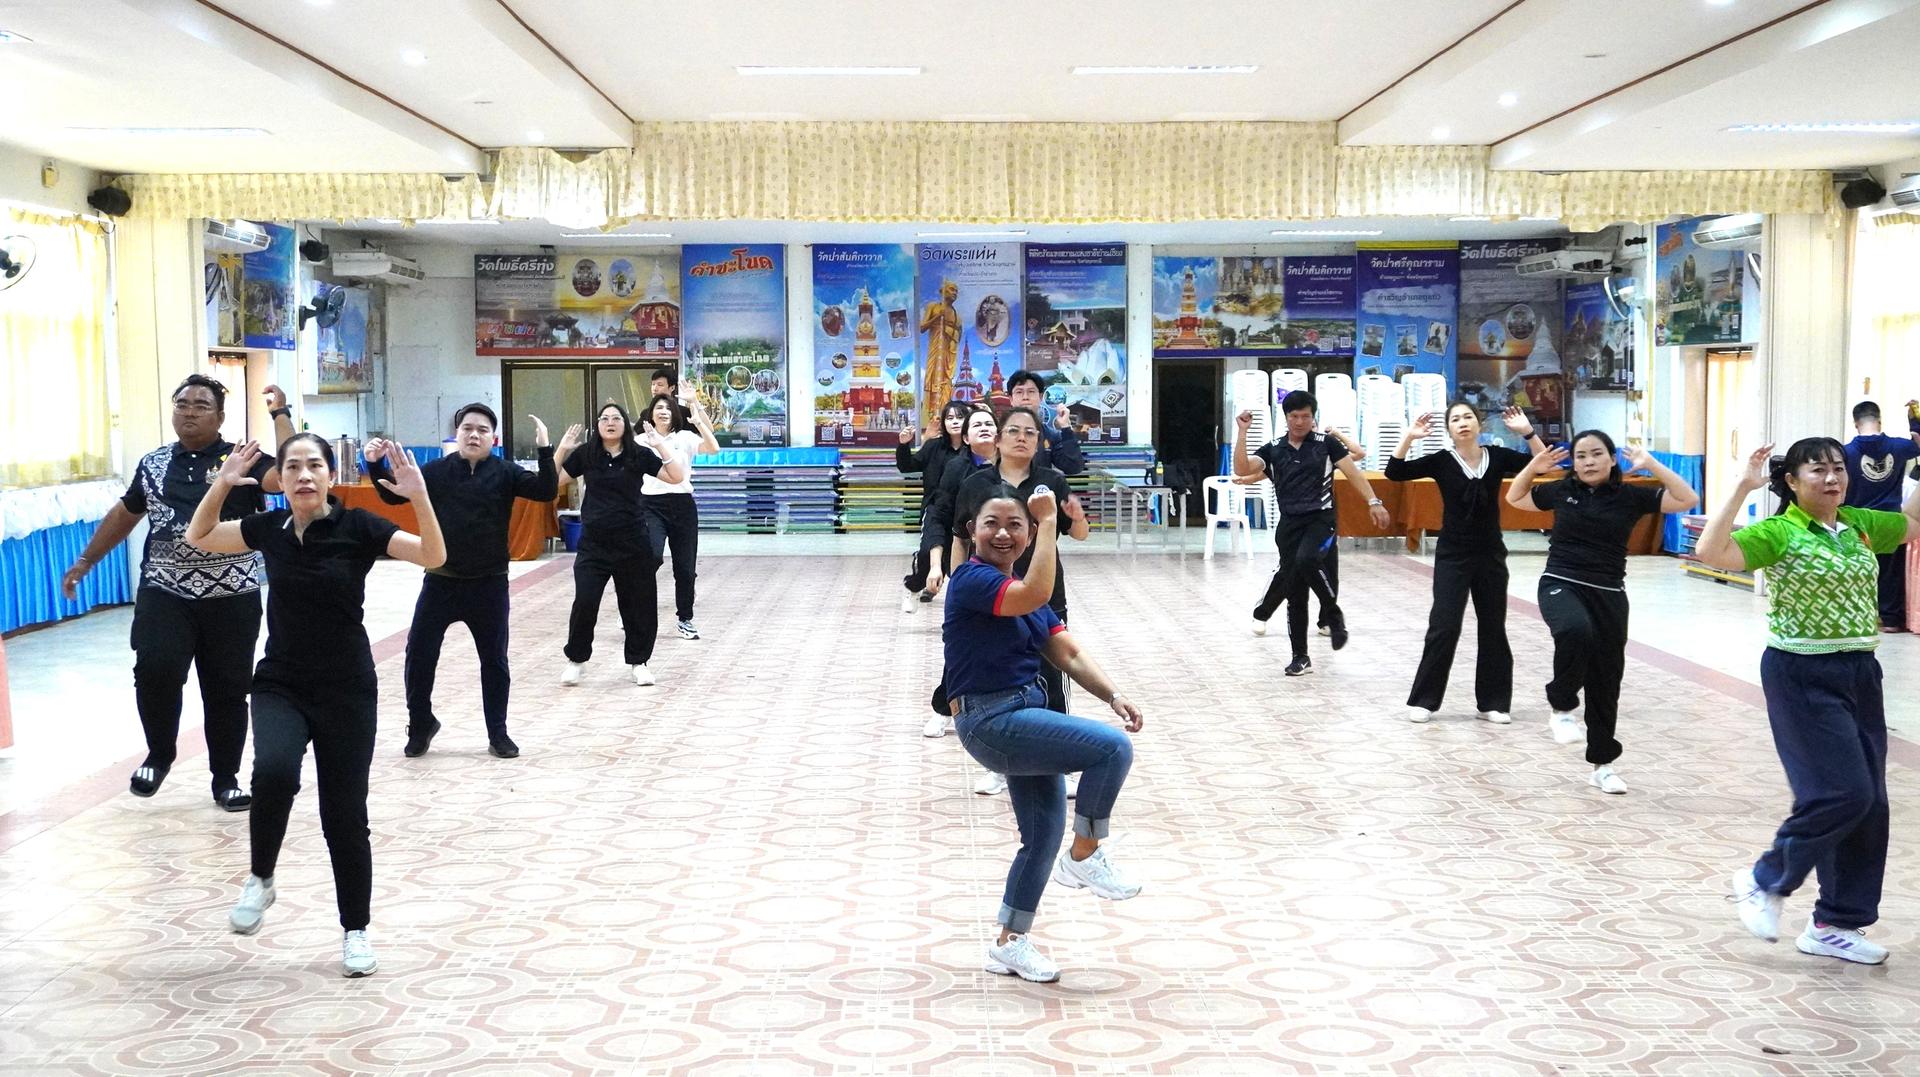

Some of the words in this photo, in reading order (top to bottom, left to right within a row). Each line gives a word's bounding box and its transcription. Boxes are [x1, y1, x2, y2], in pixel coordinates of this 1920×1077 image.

[922, 245, 997, 261] วัดพระแท่น
[1460, 242, 1547, 260] วัดโพธิ์ศรีท่ง
[477, 256, 555, 275] วัดโพธิ์ศรีทุ่ง
[689, 248, 774, 277] คำชะโนด
[1370, 252, 1445, 271] วัดป่าศรีคุณาราม
